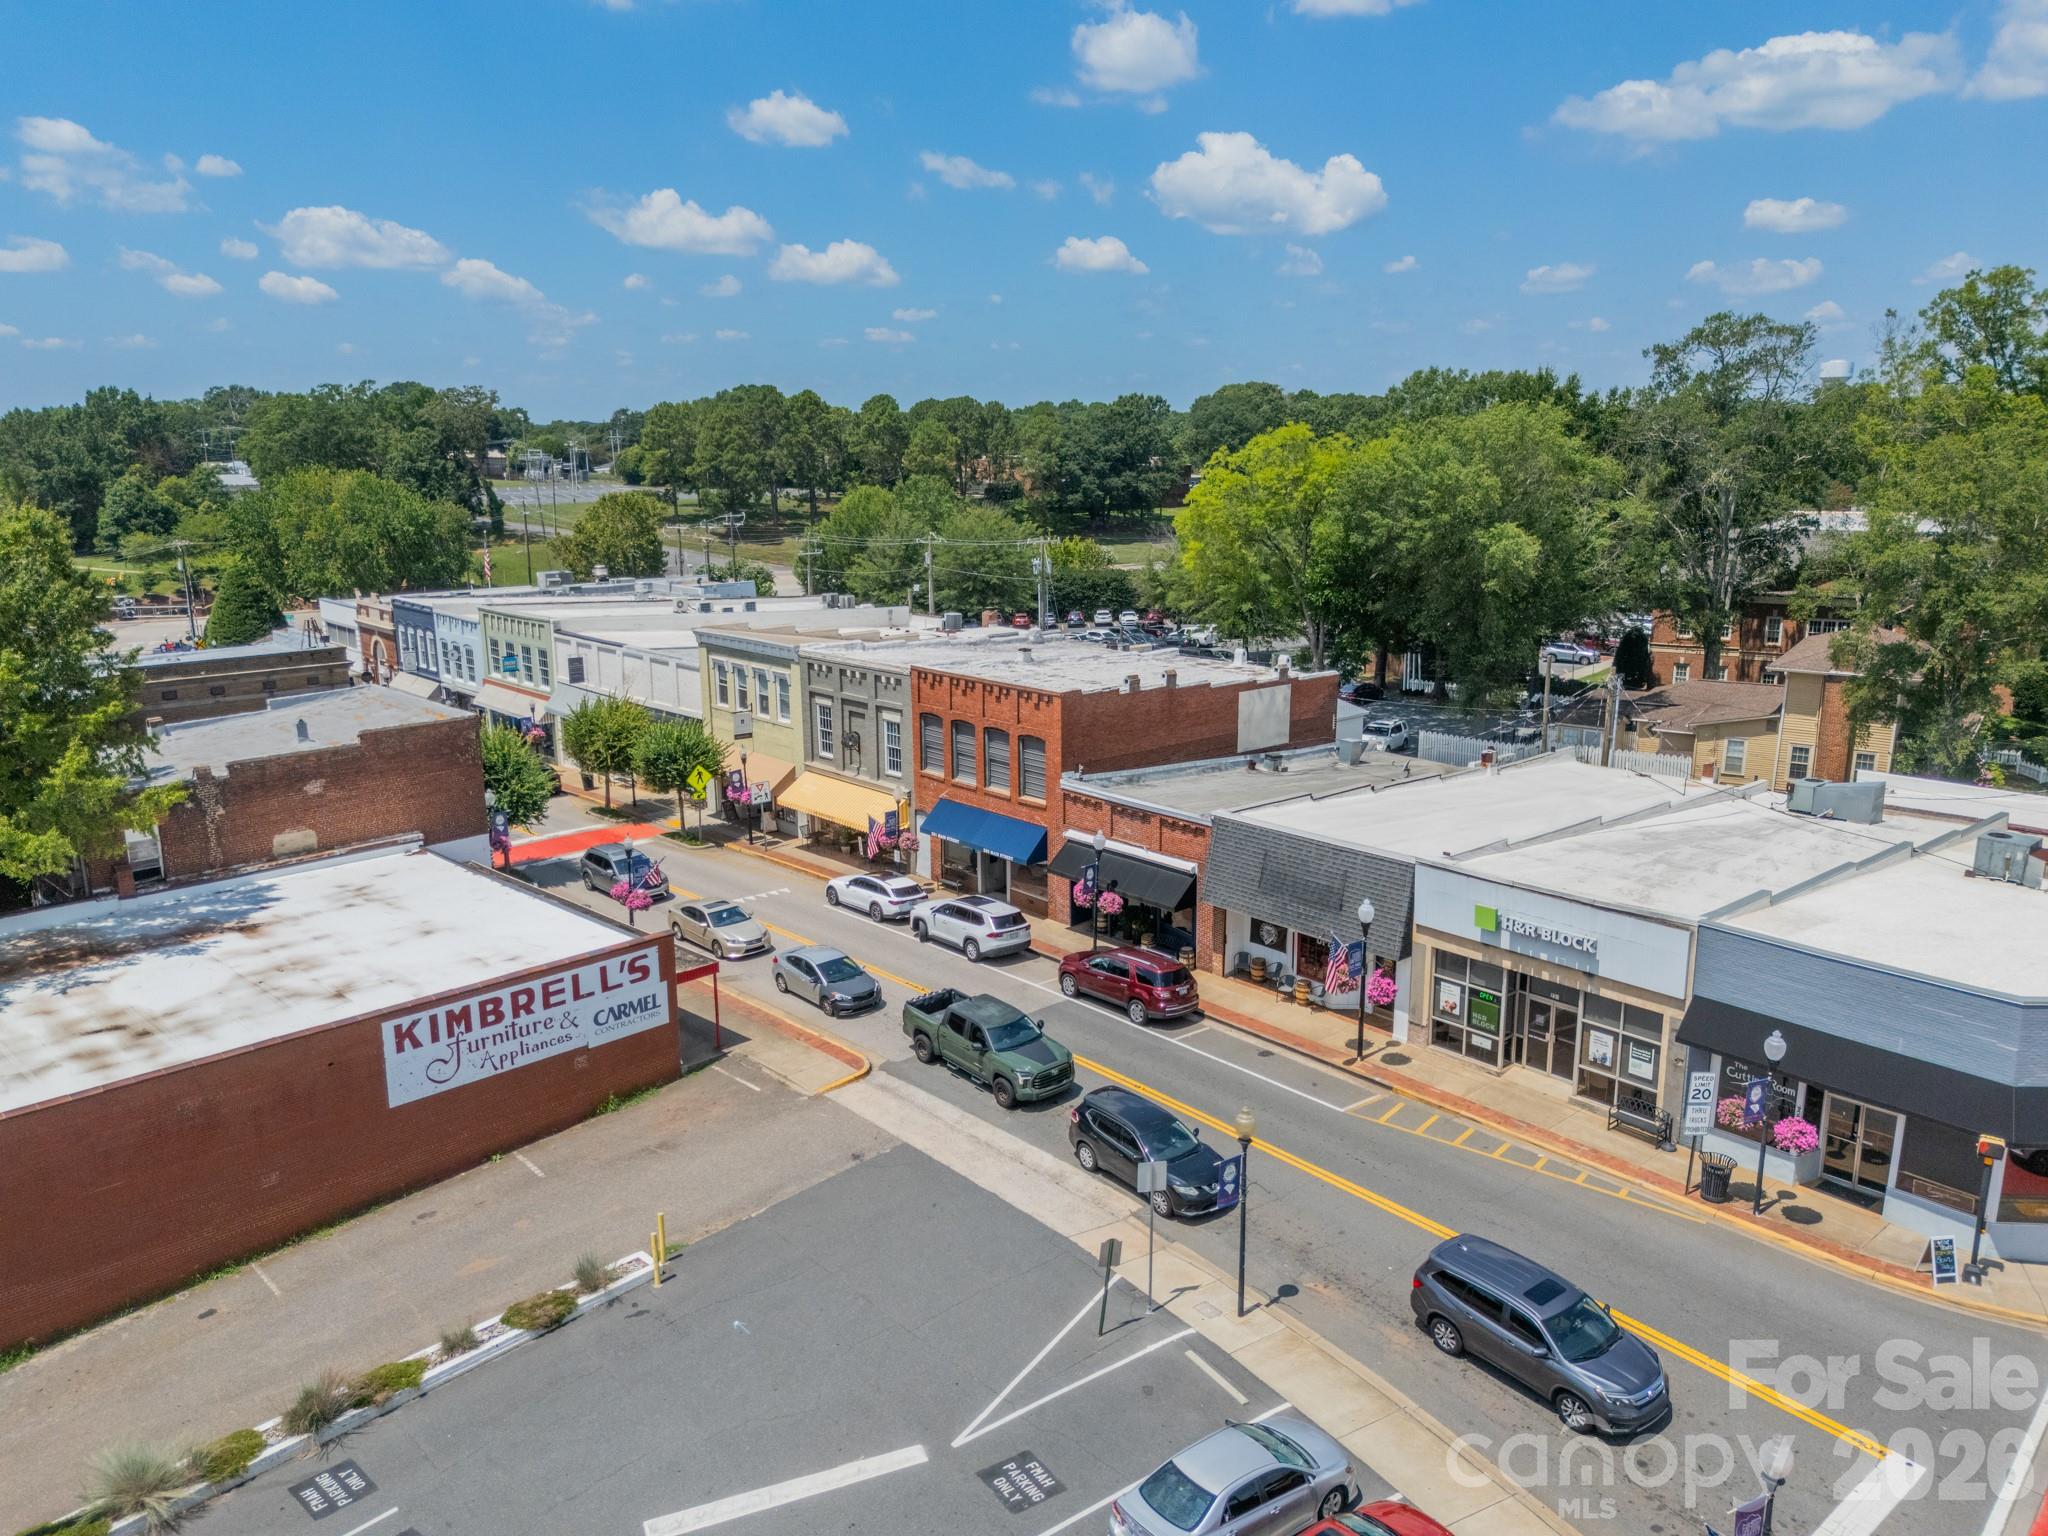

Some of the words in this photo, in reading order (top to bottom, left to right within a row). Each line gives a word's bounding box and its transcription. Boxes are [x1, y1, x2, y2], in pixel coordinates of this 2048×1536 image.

[1501, 916, 1536, 938] H&R
[1541, 927, 1597, 954] BLOCK
[394, 953, 650, 1054] KIMBRELL'S
[1479, 991, 1494, 1001] OPEN
[593, 993, 661, 1027] CARMEL
[594, 1011, 662, 1036] CONTRACTORS
[1472, 1018, 1496, 1031] BLOCK
[426, 1016, 554, 1084] Furniture
[560, 1010, 579, 1030] &
[480, 1033, 573, 1071] Appliances
[1734, 1061, 1748, 1070] The
[1691, 1088, 1711, 1100] 20
[1771, 1080, 1796, 1097] Room
[315, 1473, 353, 1507] PARKING
[338, 1469, 366, 1490] ONLY
[993, 1477, 1023, 1502] ONLY
[1002, 1462, 1045, 1502] PARKING
